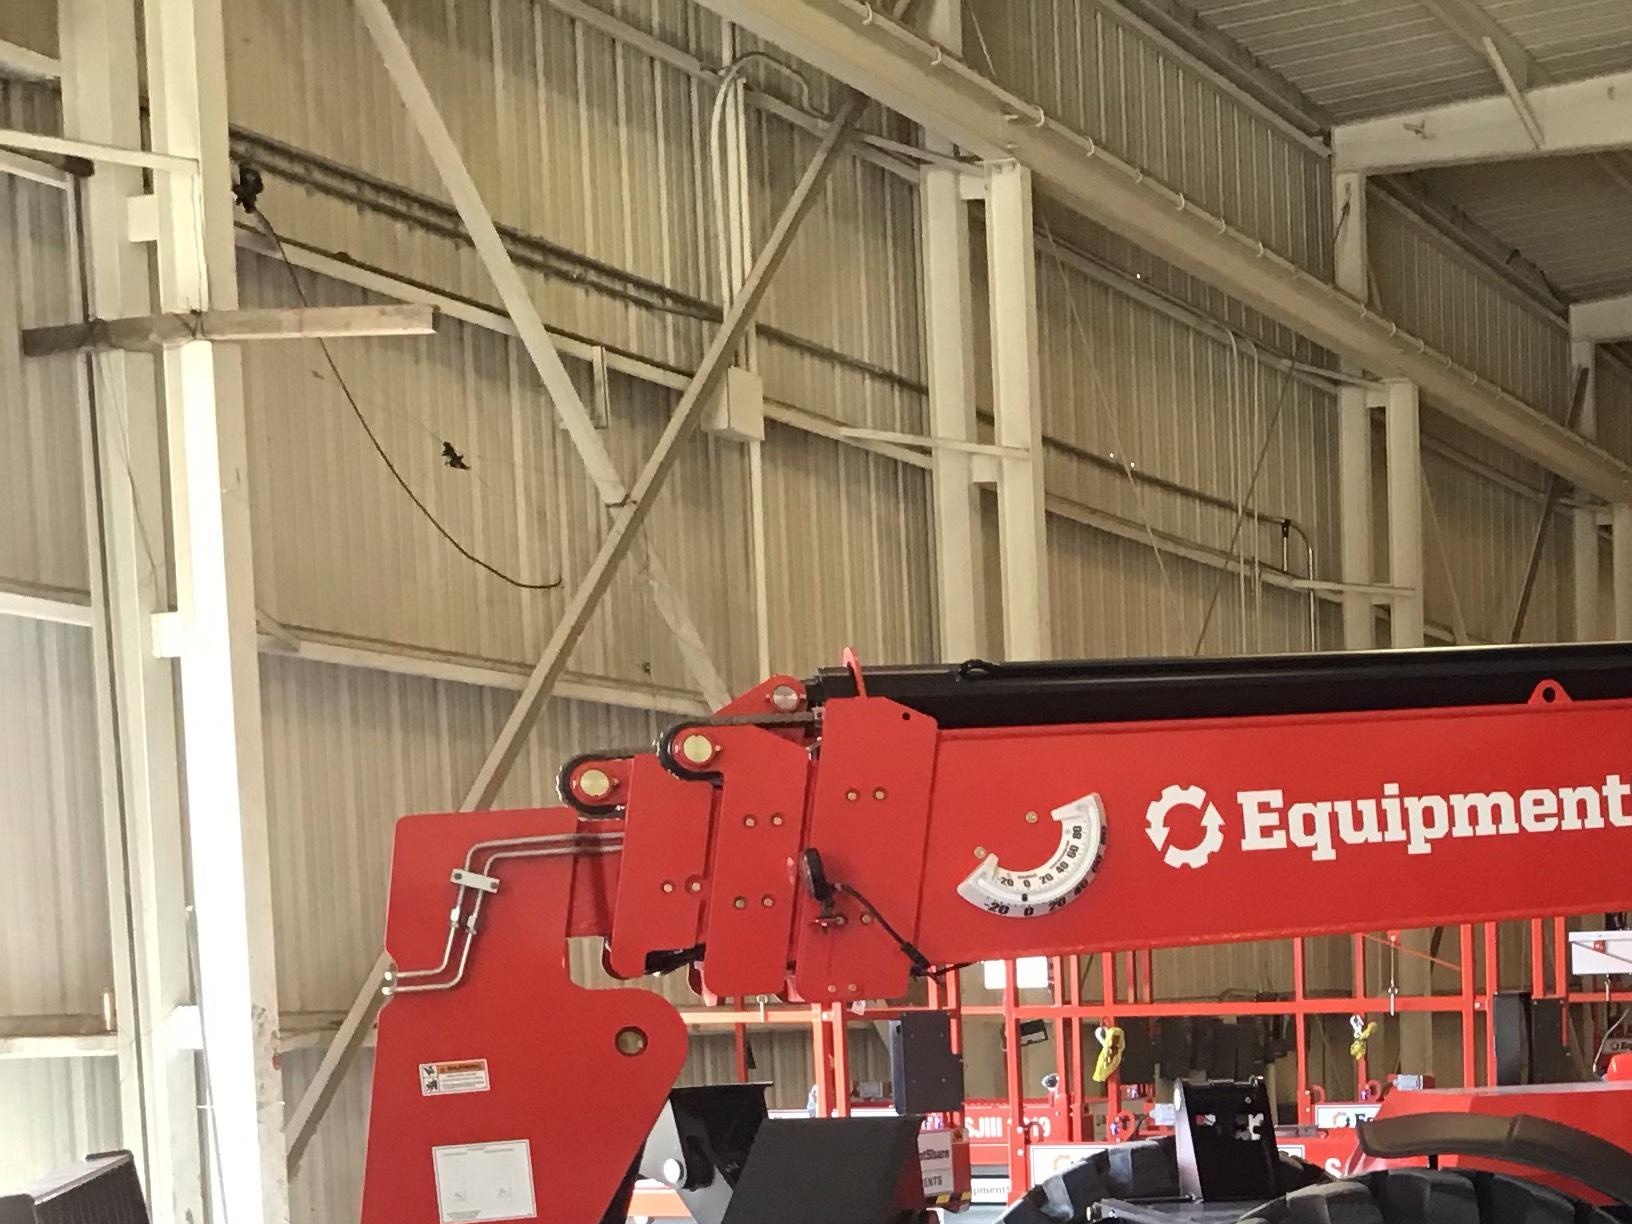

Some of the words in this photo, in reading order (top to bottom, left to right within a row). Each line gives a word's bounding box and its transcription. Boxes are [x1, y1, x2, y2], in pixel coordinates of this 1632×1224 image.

[1072, 825, 1082, 840] 80
[1067, 845, 1080, 859] 60
[1055, 861, 1069, 875] 40
[1039, 873, 1054, 885] 20
[1023, 906, 1034, 916] 0
